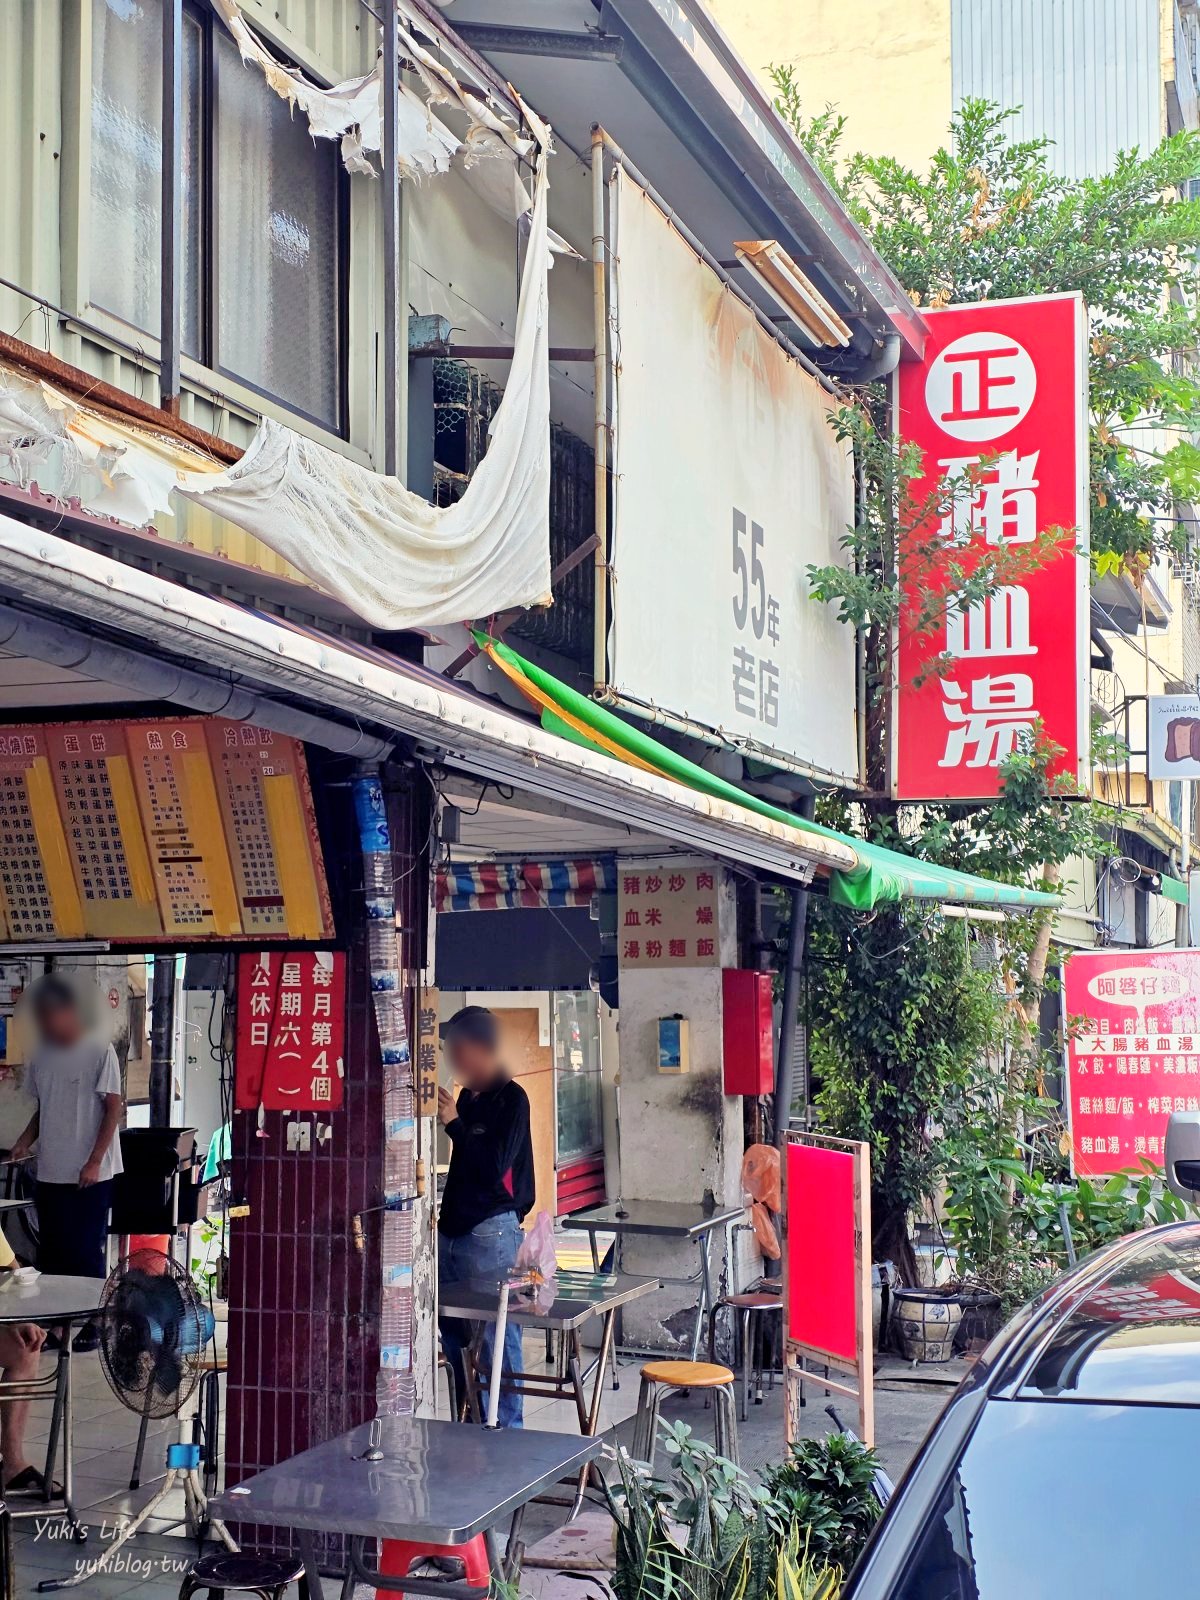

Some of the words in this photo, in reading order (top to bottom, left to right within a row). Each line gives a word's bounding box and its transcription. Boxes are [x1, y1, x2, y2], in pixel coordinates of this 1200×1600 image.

[732, 506, 779, 647] 55年
[732, 645, 780, 728] 老店
[64, 733, 105, 753] 蛋餅
[147, 730, 187, 749] 熱食
[224, 727, 273, 747] 冷熱飲
[59, 759, 106, 770] 原味蛋餅
[61, 773, 109, 785] 玉米蛋餅
[64, 787, 112, 798] 培根蛋餅
[70, 814, 117, 825] 火腿蛋餅
[0, 834, 35, 843] 腿燒餅
[73, 827, 120, 838] 起司蛋餅
[76, 840, 123, 851] 生菜蛋餅
[78, 853, 125, 864] 豬肉蛋餅
[81, 866, 128, 876] 牛肉蛋餅
[5, 884, 46, 895] 起司燒餅
[8, 897, 49, 907] 牛肉燒餅
[624, 876, 641, 959] 豬血湯
[645, 875, 662, 958] 炒米粉
[668, 874, 686, 958] 炒麵
[696, 872, 714, 956] 肉燥飯
[250, 964, 271, 1046] 公休日
[310, 964, 333, 1101] 每月第4個
[1091, 1036, 1193, 1052] 大腸豬血湯
